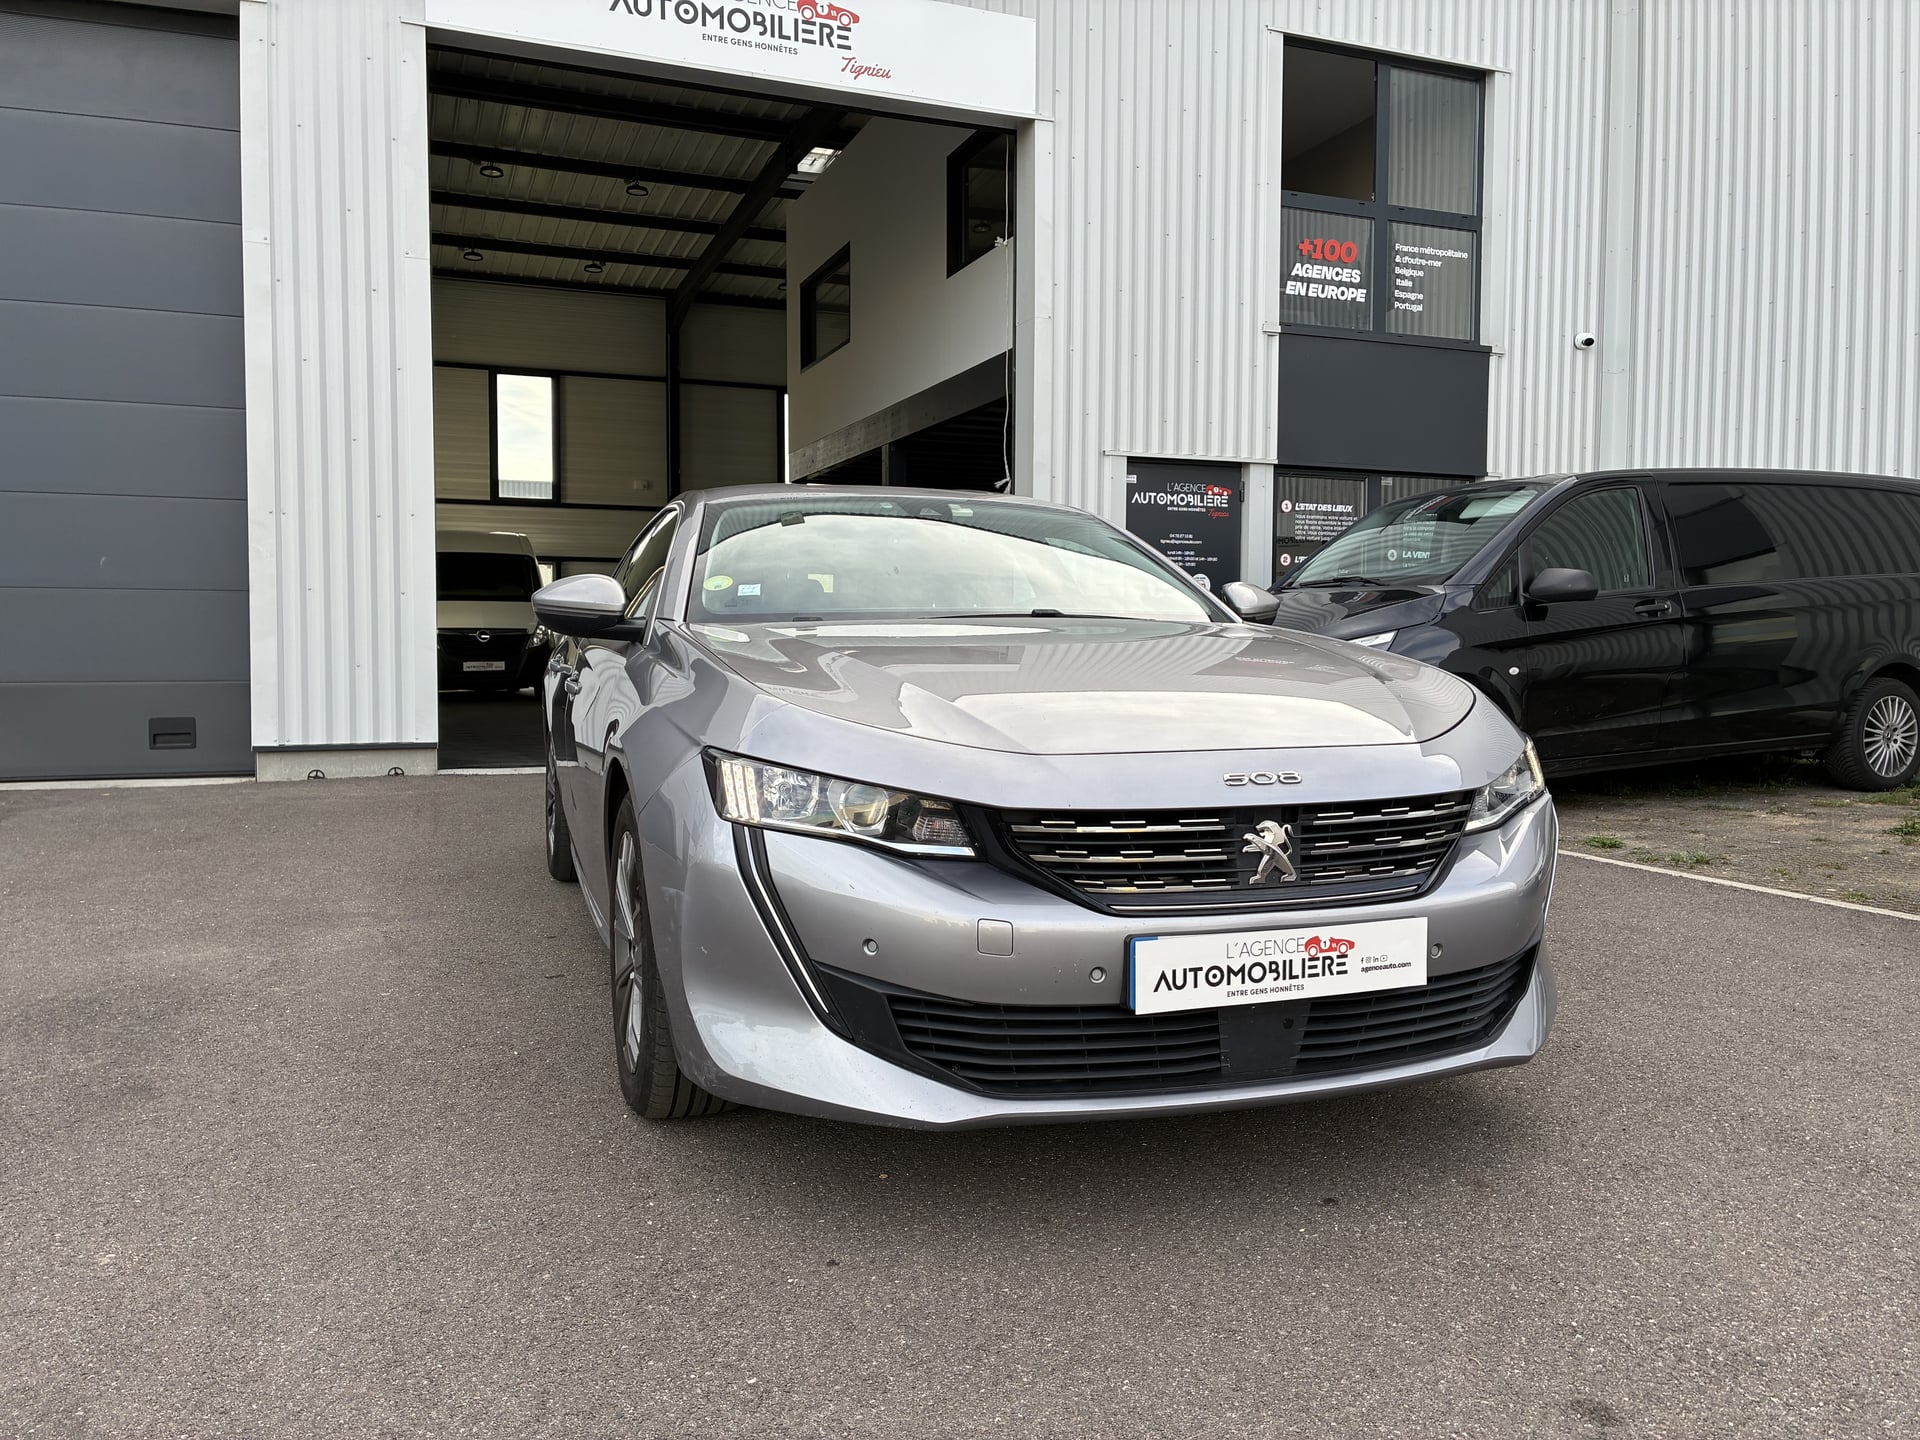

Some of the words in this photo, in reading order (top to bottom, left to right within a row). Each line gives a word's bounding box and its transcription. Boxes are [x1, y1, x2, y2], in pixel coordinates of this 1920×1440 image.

[702, 33, 729, 45] ENTRE
[730, 37, 753, 48] GENS
[754, 42, 798, 55] HONNÊTES
[841, 57, 892, 80] Tignieu
[1298, 238, 1358, 264] +100
[1395, 243, 1419, 254] France
[1419, 245, 1469, 259] métropolitaine
[1395, 254, 1402, 264] &
[1402, 255, 1443, 268] d'outre-mer
[1291, 262, 1361, 284] AGENCES
[1394, 267, 1424, 278] Belgique
[1396, 278, 1413, 288] Italie
[1285, 281, 1307, 296] EN
[1307, 283, 1367, 302] EUROPE
[1394, 289, 1424, 301] Espagne
[1394, 301, 1423, 312] Portugal
[1167, 483, 1207, 493] L'AGENCE
[1332, 504, 1353, 512] LIEUX
[1223, 771, 1303, 786] 508
[1226, 937, 1305, 960] L'AGENCE
[1361, 961, 1412, 974] agenceauto.com
[1227, 988, 1249, 998] ENTRE
[1250, 986, 1268, 996] GENS
[1269, 983, 1305, 995] HONNÊTES
